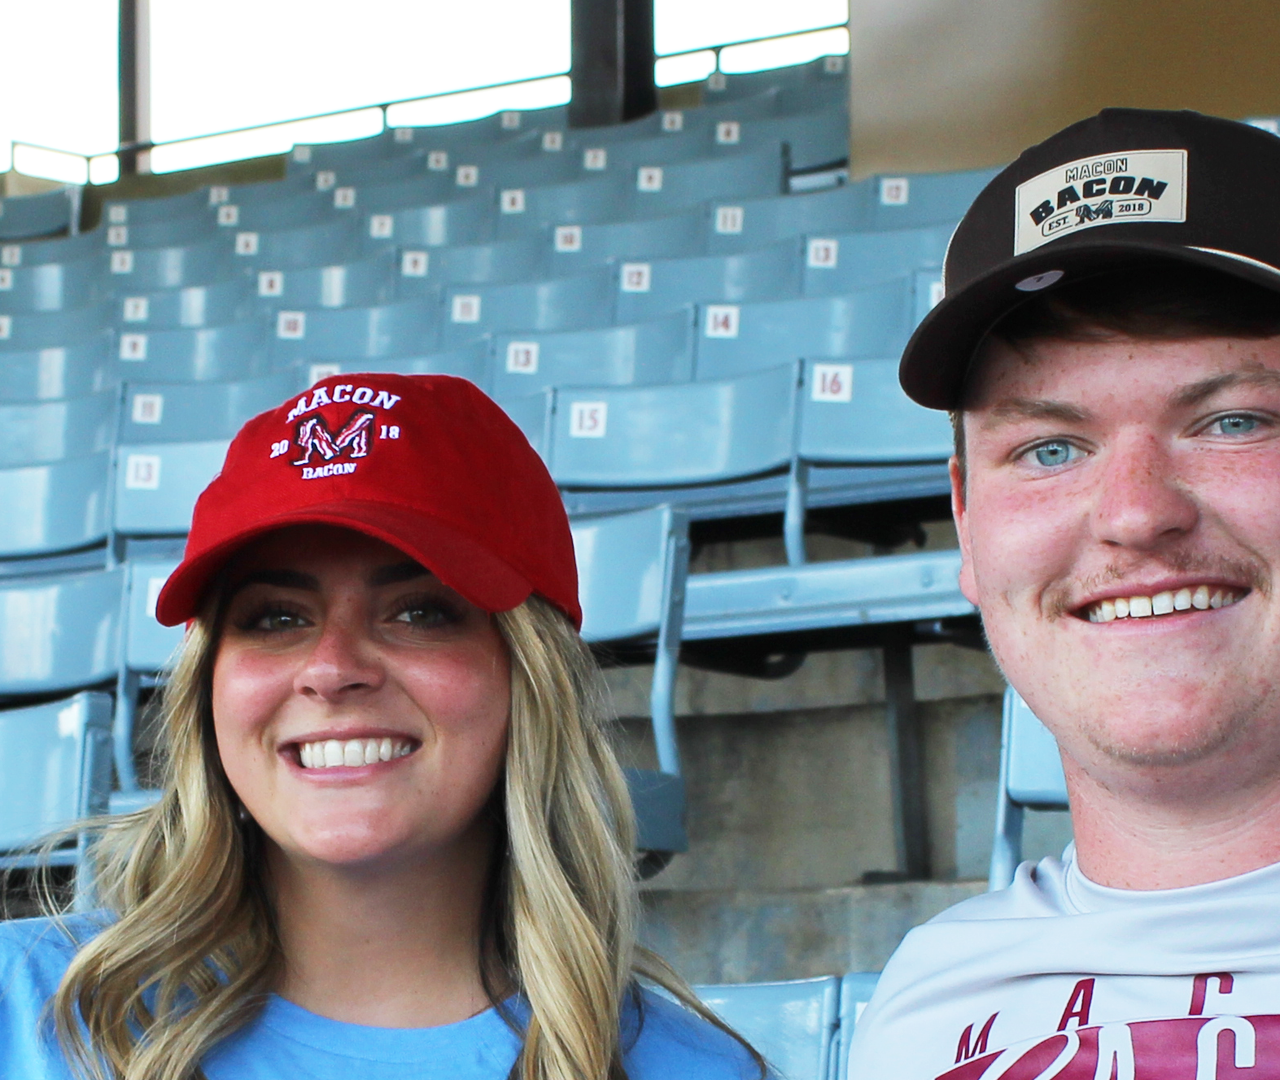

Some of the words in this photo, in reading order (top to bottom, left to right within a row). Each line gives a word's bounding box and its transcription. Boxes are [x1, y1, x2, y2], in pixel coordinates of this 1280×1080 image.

[1065, 158, 1128, 183] MACON
[1029, 176, 1169, 227] BACON
[722, 213, 736, 228] 11
[1048, 217, 1070, 232] EST.
[1074, 199, 1114, 227] M
[1118, 201, 1144, 214] 2018
[814, 246, 831, 262] 13
[629, 270, 643, 286] 12
[714, 315, 730, 330] 14
[515, 349, 531, 367] 13
[821, 373, 842, 394] 16
[286, 384, 401, 424] MACON
[579, 409, 598, 430] 15
[270, 440, 290, 458] 20
[291, 409, 375, 466] M
[380, 425, 401, 439] 18
[135, 463, 153, 482] 13
[301, 462, 357, 480] BACON
